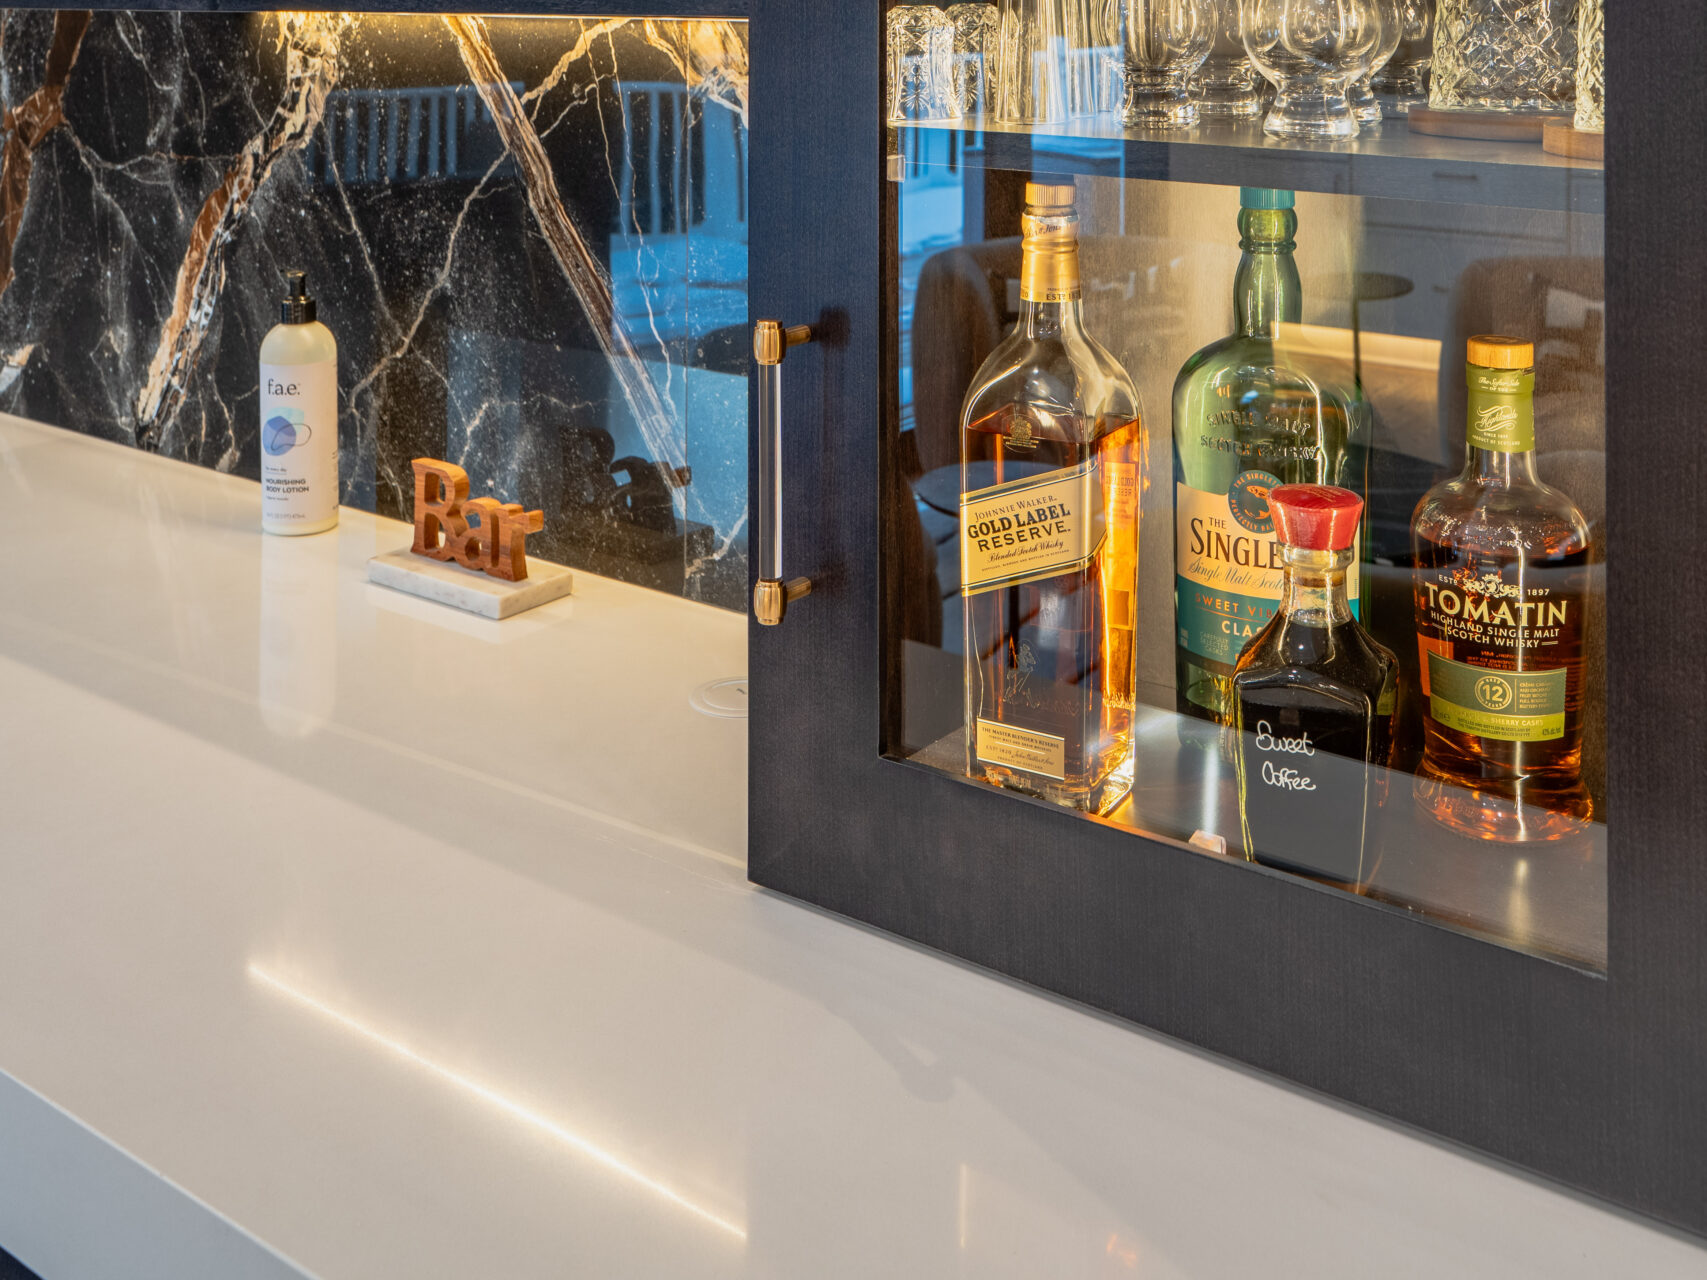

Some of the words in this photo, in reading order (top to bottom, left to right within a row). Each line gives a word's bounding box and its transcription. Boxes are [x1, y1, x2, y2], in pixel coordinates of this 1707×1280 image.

[1200, 434, 1251, 456] SCOTCH
[265, 478, 306, 486] NOURISHING
[266, 485, 281, 493] BODY
[410, 457, 544, 582] Bar
[968, 517, 1012, 539] GOLD
[1013, 503, 1072, 528] LABEL
[974, 504, 1015, 523] JOHNNIE
[1208, 516, 1227, 529] THE
[987, 548, 1018, 562] Blended
[1017, 544, 1039, 557] Scotch
[1039, 540, 1064, 552] Whisky
[1189, 556, 1223, 582] Single
[1225, 567, 1252, 585] Malt
[1195, 592, 1239, 613] SWEET
[1527, 588, 1550, 596] 1897
[1425, 581, 1567, 627] TOMATIN
[1431, 610, 1483, 633] HIGHLAND
[1487, 626, 1530, 639] SINGLE
[1533, 628, 1559, 639] MALT
[1447, 626, 1490, 645] SCOTCH
[1494, 637, 1540, 648] WHISKY
[1482, 684, 1503, 702] 12
[1484, 701, 1504, 709] YEARS
[1491, 717, 1519, 726] SHERRY
[1521, 719, 1544, 727] CASKS
[992, 729, 1011, 737] MASTER
[1012, 733, 1038, 744] BLENDER'S
[1039, 739, 1059, 749] RESERVE
[1256, 720, 1315, 756] Sweet
[1262, 760, 1317, 790] Coffee
